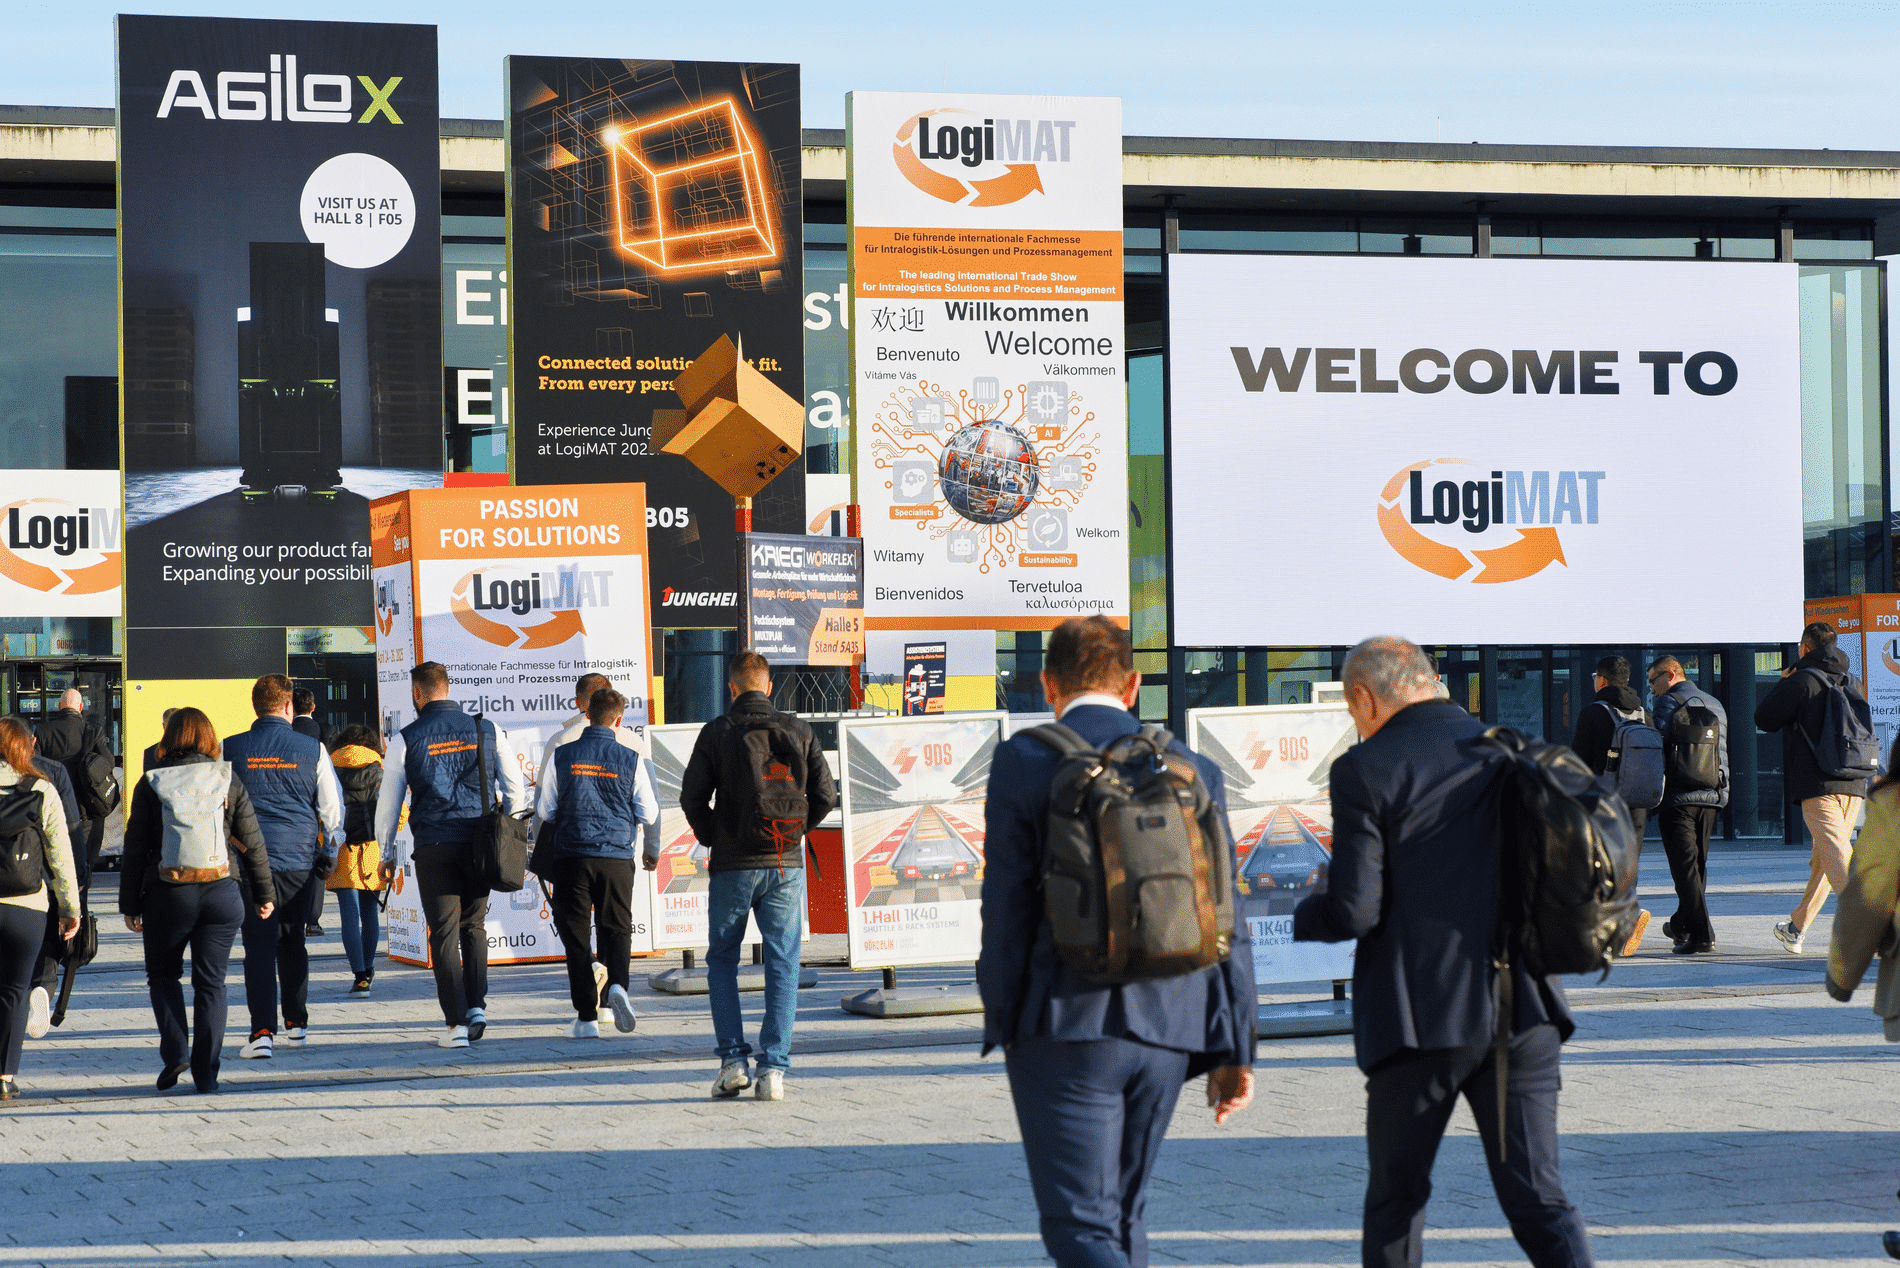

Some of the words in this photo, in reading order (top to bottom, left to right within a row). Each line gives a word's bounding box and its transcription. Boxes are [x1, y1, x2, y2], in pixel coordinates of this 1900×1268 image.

[919, 117, 1076, 167] LogiMAT
[318, 197, 354, 209] VISIT
[357, 198, 376, 209] US
[379, 198, 398, 210] AT
[314, 212, 351, 224] HALL
[355, 212, 363, 224] 8
[379, 213, 402, 225] F05
[894, 232, 910, 242] Die
[912, 233, 956, 243] führende
[958, 233, 1024, 243] internationale
[1026, 234, 1081, 244] Fachmesse
[865, 244, 879, 254] für
[881, 244, 990, 257] Intralogistik-Lösungen
[992, 246, 1011, 255] und
[1013, 246, 1113, 258] Prozessmanagement
[899, 270, 917, 280] The
[919, 270, 955, 282] leading
[957, 271, 1018, 281] international
[1020, 272, 1048, 281] Trade
[1050, 272, 1077, 282] Show
[862, 282, 877, 292] for
[879, 282, 942, 295] Intralogistics
[944, 283, 990, 293] Solutions
[992, 284, 1011, 293] and
[1013, 284, 1052, 294] Process
[1055, 285, 1116, 296] Management
[870, 305, 926, 333] 欢迎
[945, 301, 1089, 322] Willkommen
[985, 330, 1113, 355] Welcome
[877, 347, 960, 362] Benvenuto
[538, 355, 632, 371] Connected
[758, 358, 783, 372] fit.
[1043, 364, 1116, 376] Välkommen
[1229, 346, 1620, 395] WELCOME
[1638, 350, 1738, 396] TO
[864, 371, 897, 380] Vítáme
[899, 371, 917, 380] Vás
[538, 376, 585, 390] From
[588, 379, 637, 394] every
[808, 390, 850, 429] a
[538, 423, 616, 439] Experience
[538, 445, 551, 456] at
[556, 443, 617, 458] LogiMAT
[480, 498, 579, 520] PASSION
[1409, 470, 1606, 534] LogiMAT
[894, 508, 934, 518] Specialists
[440, 528, 486, 549] FOR
[492, 524, 621, 546] SOLUTIONS
[1075, 528, 1120, 538] Welkom
[163, 542, 238, 562] Growing
[242, 544, 273, 558] our
[278, 541, 347, 562] product
[751, 544, 804, 568] KRIEG
[806, 550, 853, 567] WORKFLEX
[873, 550, 924, 565] Witamy
[1023, 555, 1073, 566] Sustainability
[163, 564, 256, 585] Expanding
[259, 567, 300, 585] your
[472, 570, 614, 616] LogiMAT
[875, 587, 964, 600] Bienvenidos
[1008, 580, 1083, 593] Tervetuloa
[662, 592, 738, 607] JUNGHEI
[1025, 596, 1114, 612] καλωσόρισμα
[825, 617, 851, 632] Halle
[853, 617, 859, 632] 5
[1838, 618, 1848, 628] See
[1849, 619, 1860, 629] you
[1876, 615, 1900, 626] FOR
[814, 640, 839, 653] Stand
[500, 661, 556, 670] Fachmesse
[558, 660, 571, 669] für
[573, 659, 638, 670] Intralogistik-
[448, 675, 493, 686] ösungen
[496, 675, 515, 685] und
[459, 695, 515, 713] rzlich
[664, 896, 699, 909] 1.Hall
[664, 910, 694, 918] SHUTTLE
[862, 909, 901, 924] 1.Hall
[904, 906, 938, 921] 1K40
[863, 924, 896, 933] SHUTTLE
[926, 920, 960, 929] SYSTEMS
[1258, 920, 1293, 936] 1K40
